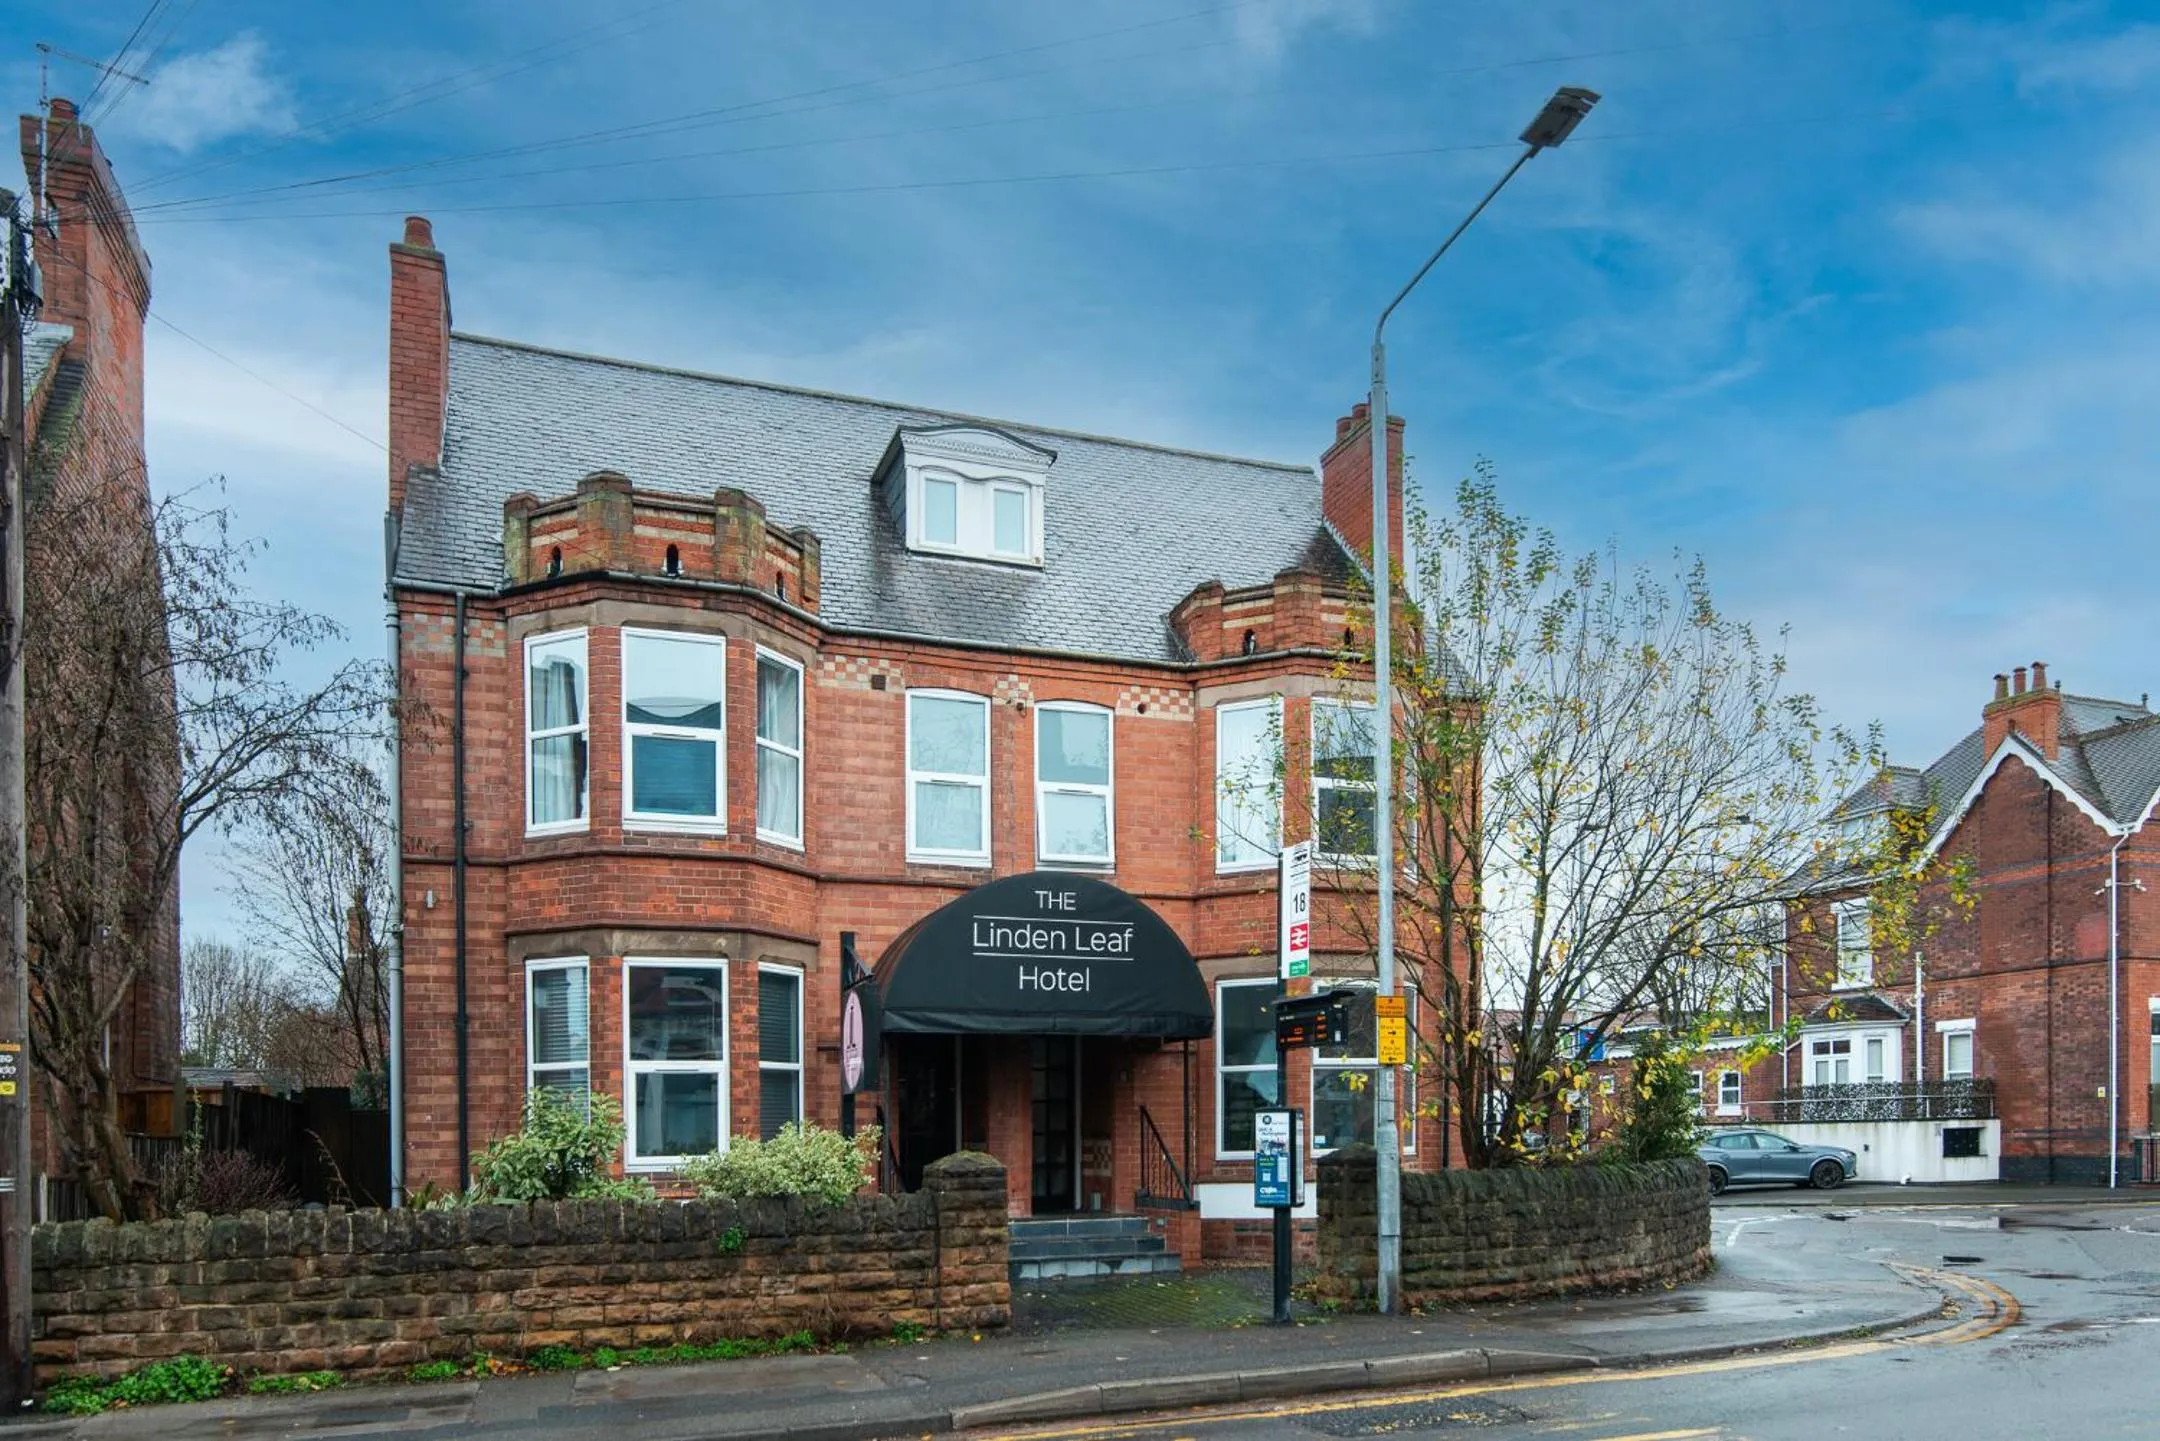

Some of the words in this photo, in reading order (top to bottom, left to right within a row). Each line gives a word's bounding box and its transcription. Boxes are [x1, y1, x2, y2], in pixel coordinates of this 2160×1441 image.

[1034, 890, 1077, 911] THE
[1293, 892, 1306, 914] 18
[973, 922, 1066, 950] Linden
[1075, 926, 1134, 953] Leaf
[1018, 965, 1090, 992] Hotel
